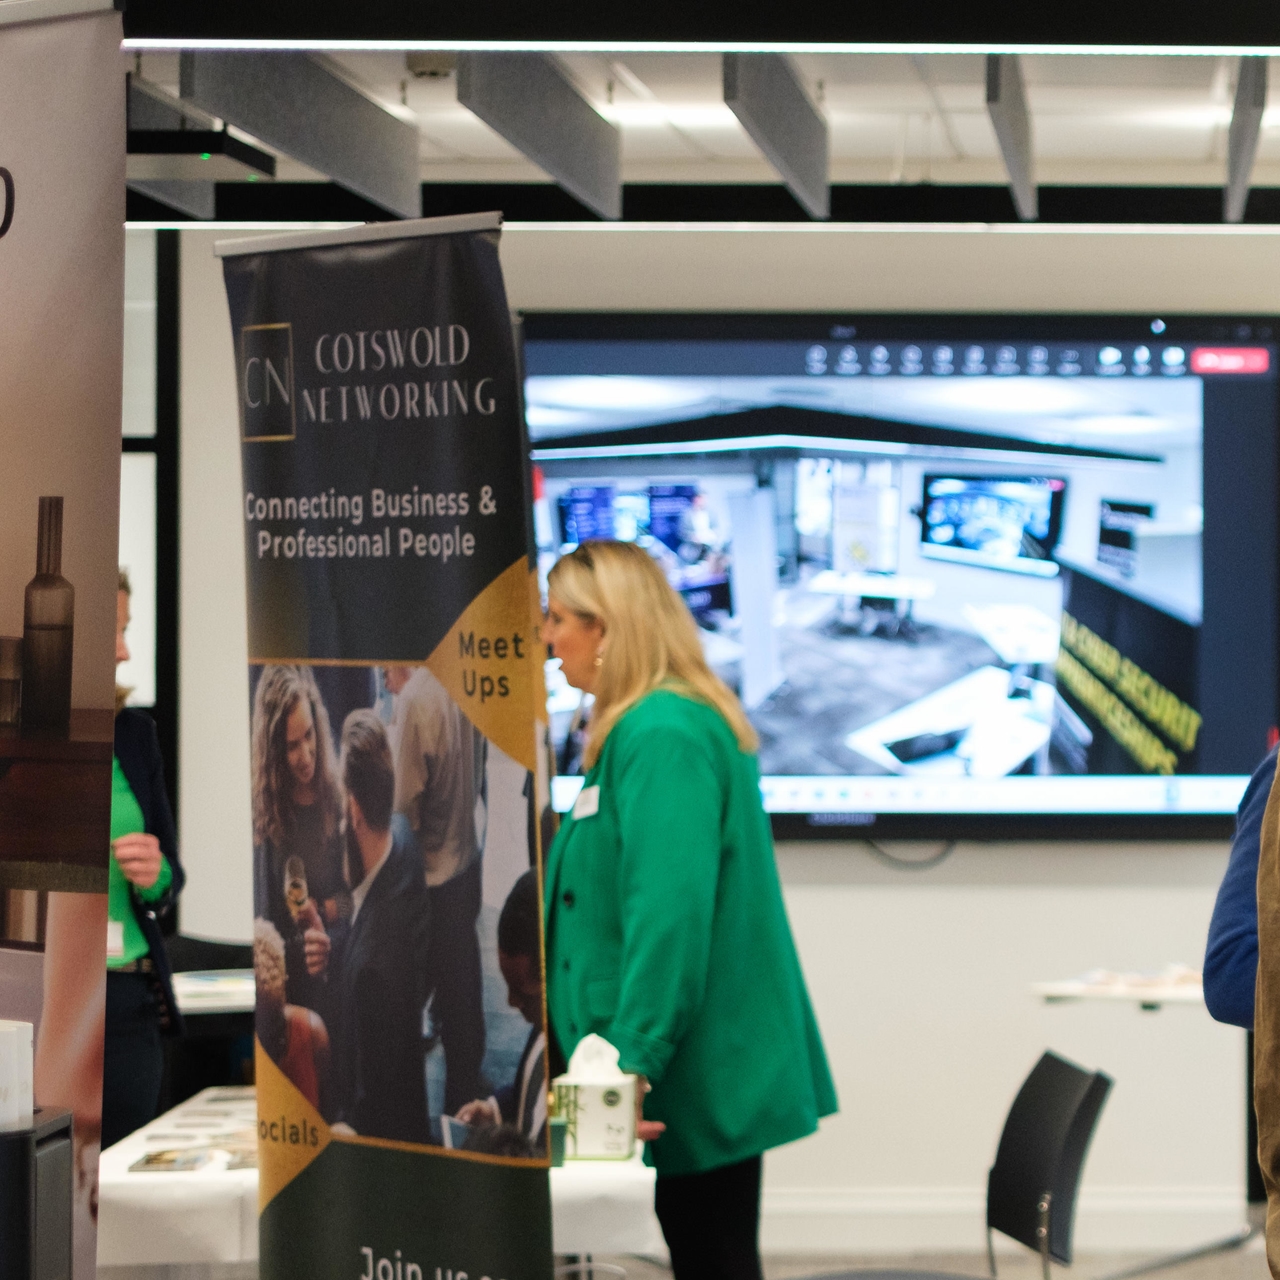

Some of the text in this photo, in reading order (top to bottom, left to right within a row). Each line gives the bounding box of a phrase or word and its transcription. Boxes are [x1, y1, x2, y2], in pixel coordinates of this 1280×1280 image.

[315, 324, 470, 374] COTSWOLD
[303, 377, 496, 423] NETWORKING
[246, 484, 497, 526] Connecting Business &
[257, 524, 476, 563] Professional People
[459, 630, 525, 659] Meet
[463, 669, 510, 703] Ups
[258, 1118, 320, 1148] ocials
